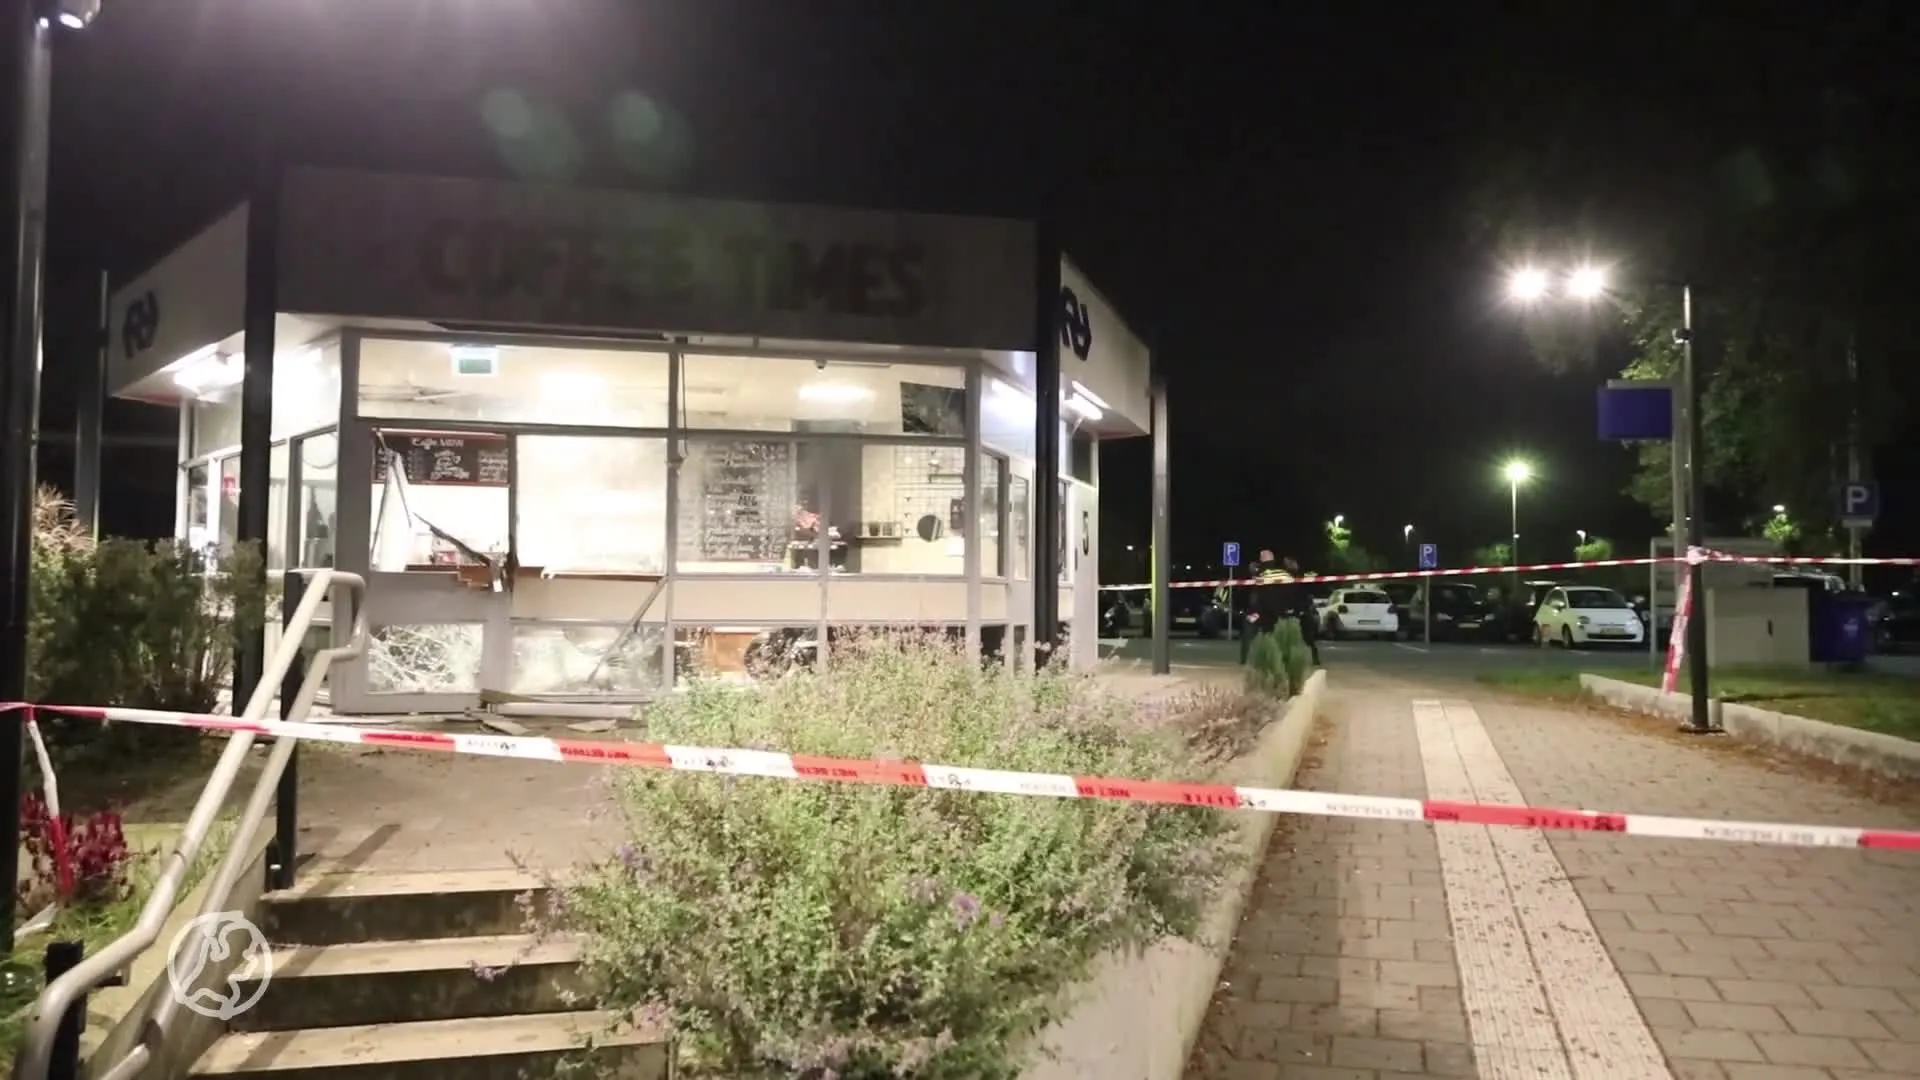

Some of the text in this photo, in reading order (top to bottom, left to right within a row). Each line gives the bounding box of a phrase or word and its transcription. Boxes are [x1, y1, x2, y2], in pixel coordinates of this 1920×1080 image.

[417, 218, 926, 318] COFFEE TIMES
[1847, 486, 1869, 512] P
[1227, 544, 1237, 557] P
[1423, 546, 1433, 558] P
